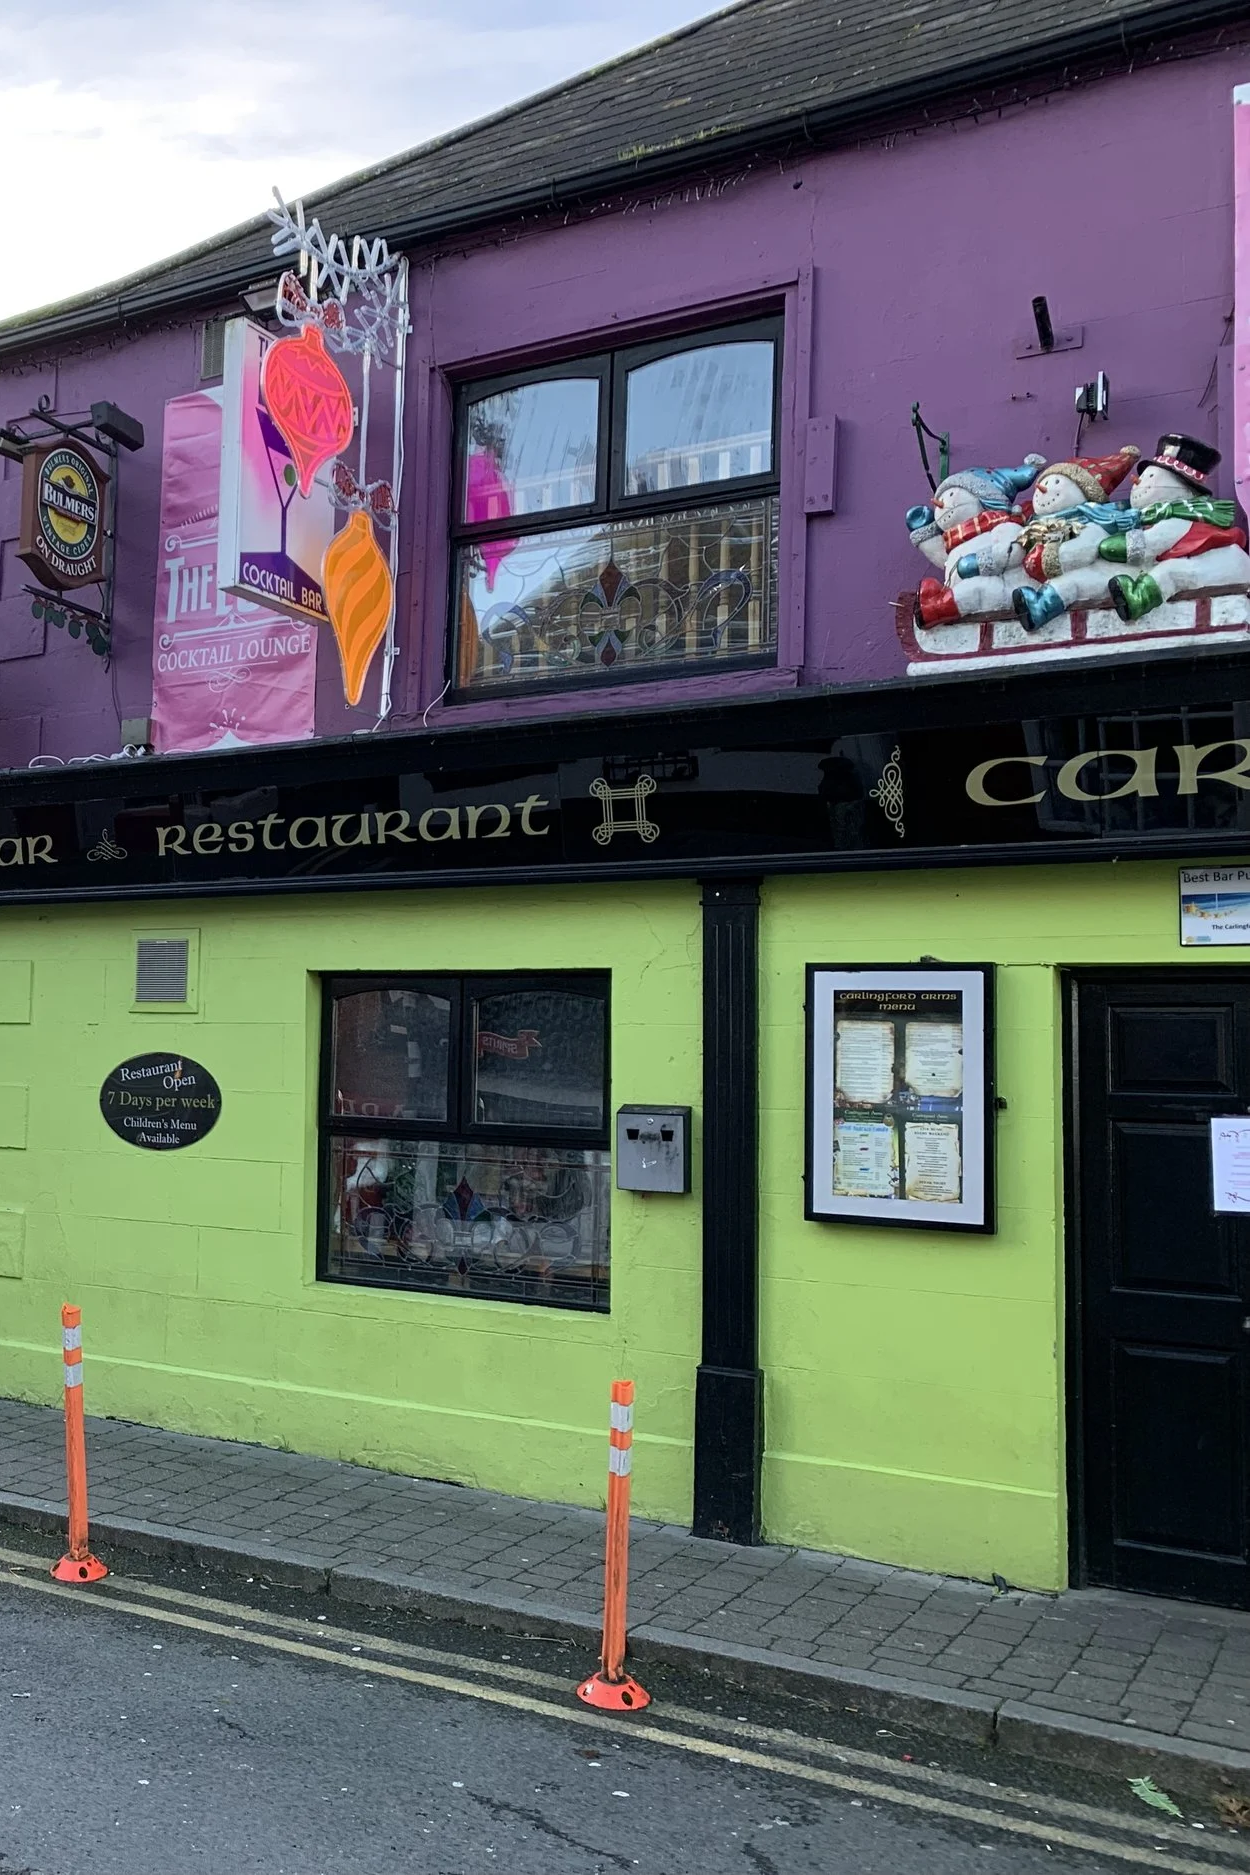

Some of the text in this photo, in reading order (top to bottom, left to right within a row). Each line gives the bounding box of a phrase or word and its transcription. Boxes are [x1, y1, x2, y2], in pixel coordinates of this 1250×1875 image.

[71, 457, 94, 494] ORIGINAL
[44, 482, 95, 521] BULMERS
[43, 515, 70, 555] VINTAGE
[72, 535, 93, 556] CIDER
[36, 535, 97, 576] ON DRAUGHT
[164, 556, 214, 624] THE
[242, 561, 297, 602] COCKTAIL
[301, 586, 323, 612] BAR
[157, 633, 312, 672] COCKTAIL LOUNGE
[1183, 872, 1209, 883] Best
[1213, 871, 1233, 882] Bar
[120, 1060, 183, 1082] Restaurant
[162, 1075, 196, 1092] Open
[107, 1091, 216, 1111] 7 Days per week
[123, 1116, 197, 1131] Children's Menu
[139, 1132, 180, 1144] Available
